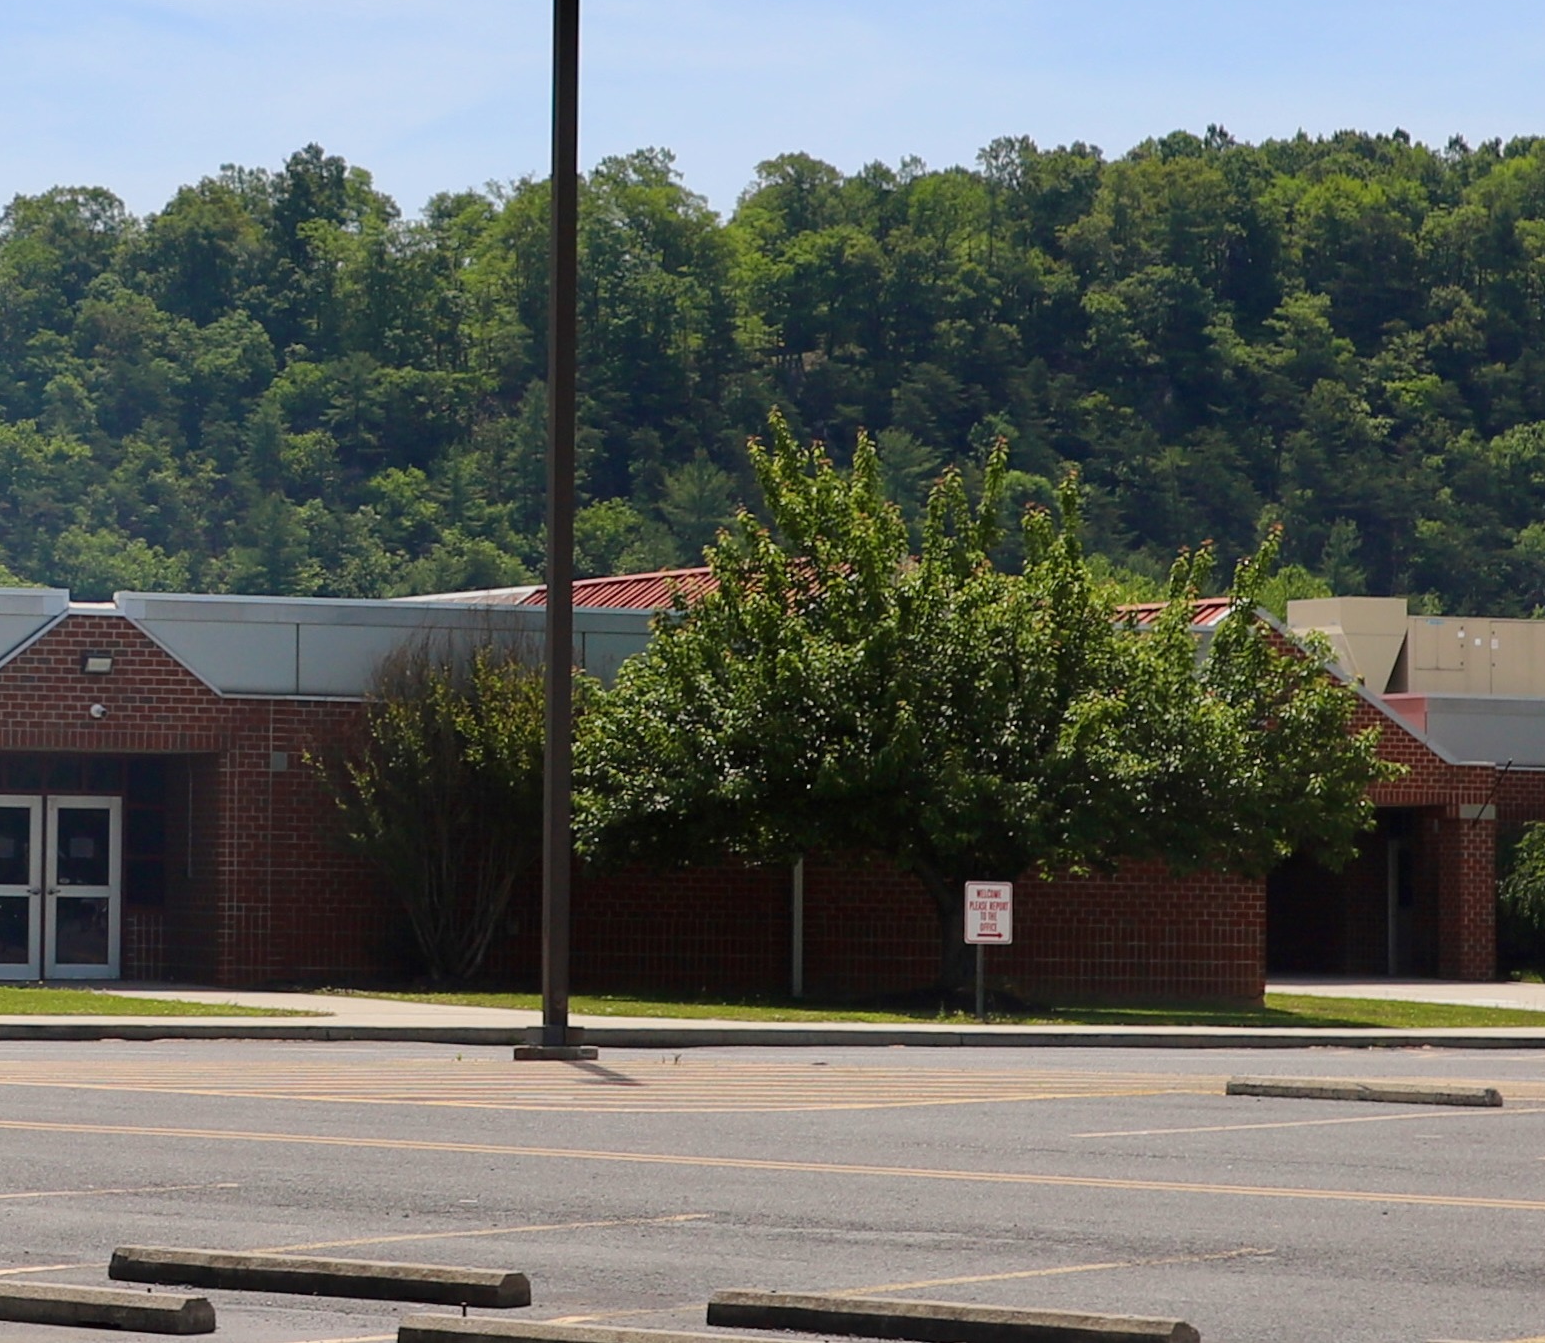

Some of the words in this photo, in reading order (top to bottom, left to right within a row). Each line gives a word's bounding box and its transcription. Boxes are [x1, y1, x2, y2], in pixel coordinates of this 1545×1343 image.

[976, 889, 1001, 898] WELCOME
[969, 901, 988, 911] PLEASE
[989, 901, 1009, 911] REPORT
[980, 911, 987, 921] TO
[988, 911, 997, 921] THE
[980, 922, 997, 932] OFFICE
